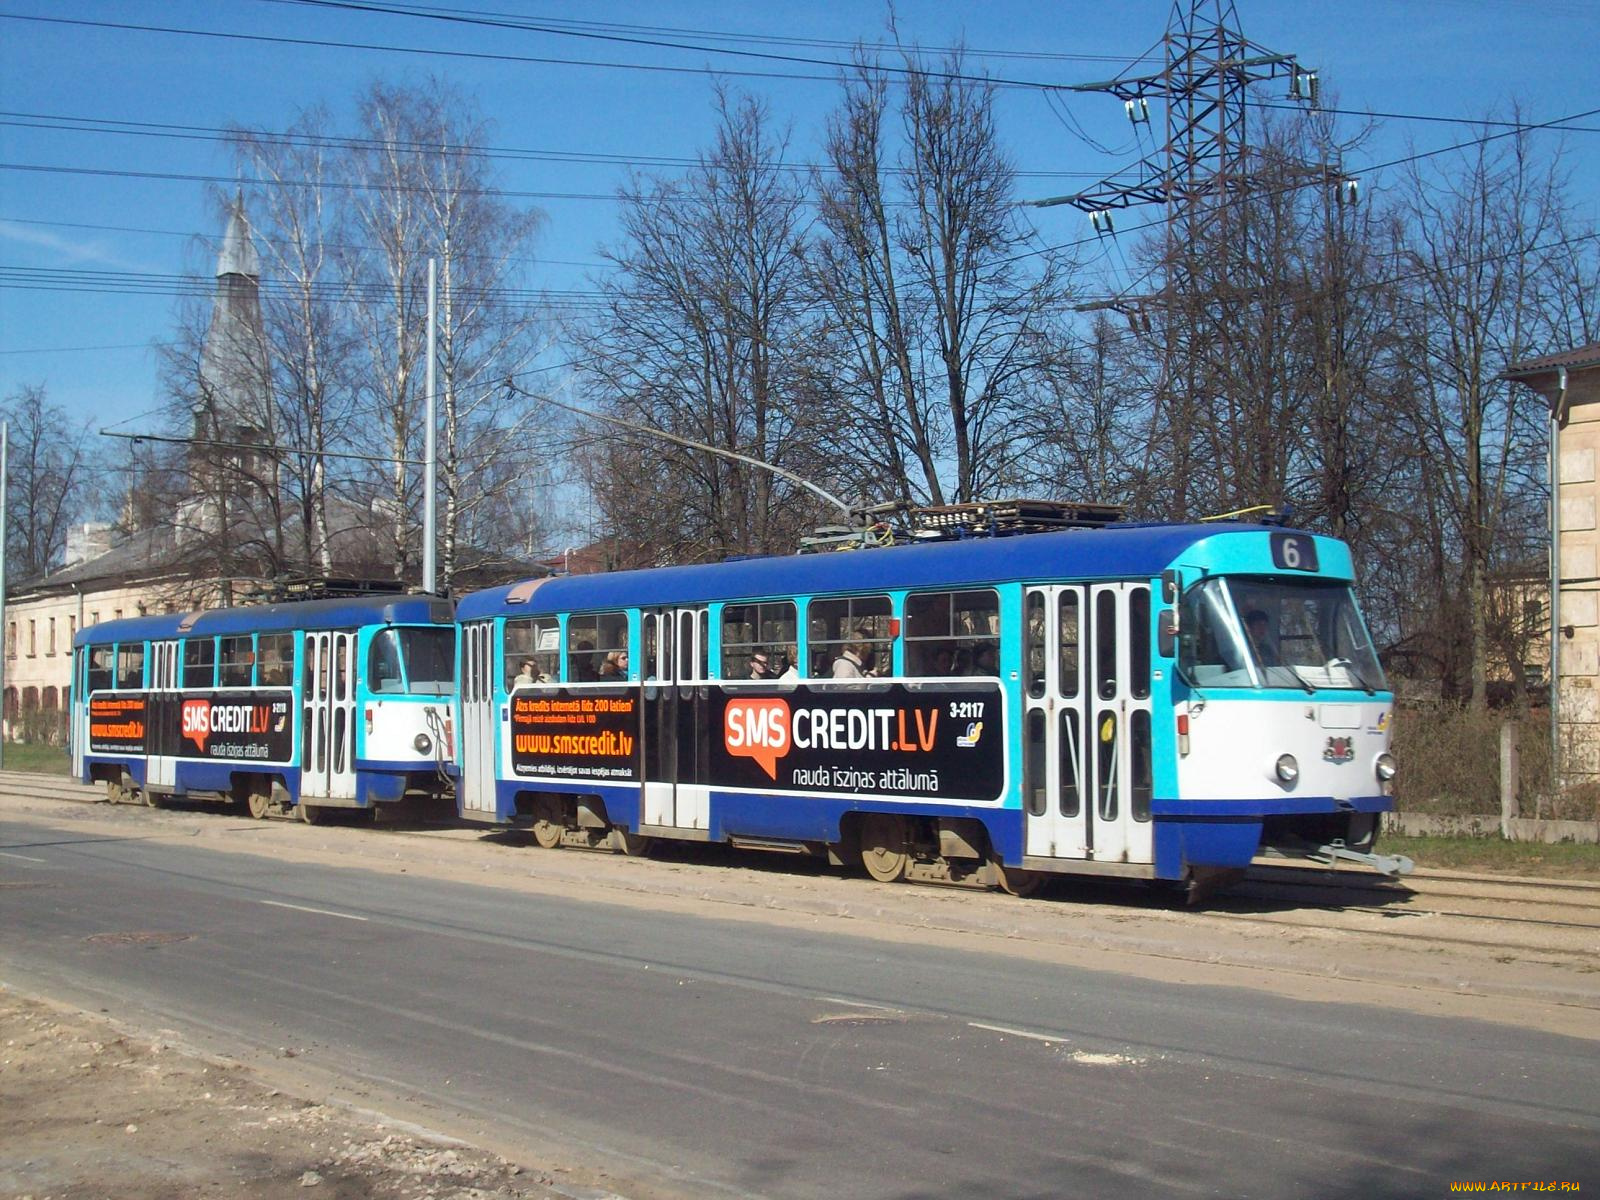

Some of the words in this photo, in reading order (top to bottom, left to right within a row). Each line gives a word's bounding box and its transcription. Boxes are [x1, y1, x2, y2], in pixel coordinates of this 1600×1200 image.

[1282, 538, 1300, 567] 6
[183, 706, 209, 732] SMS
[210, 705, 269, 733] CREDIT.LV
[551, 700, 580, 712] internetā
[594, 699, 609, 712] 200
[950, 702, 984, 718] 3-2117
[727, 707, 786, 748] SMS
[792, 708, 939, 752] CREDIT.LV
[516, 731, 632, 756] www.smscredit.lv
[793, 765, 830, 786] nauda
[833, 766, 876, 792] īsziņas
[879, 768, 939, 791] attālumā
